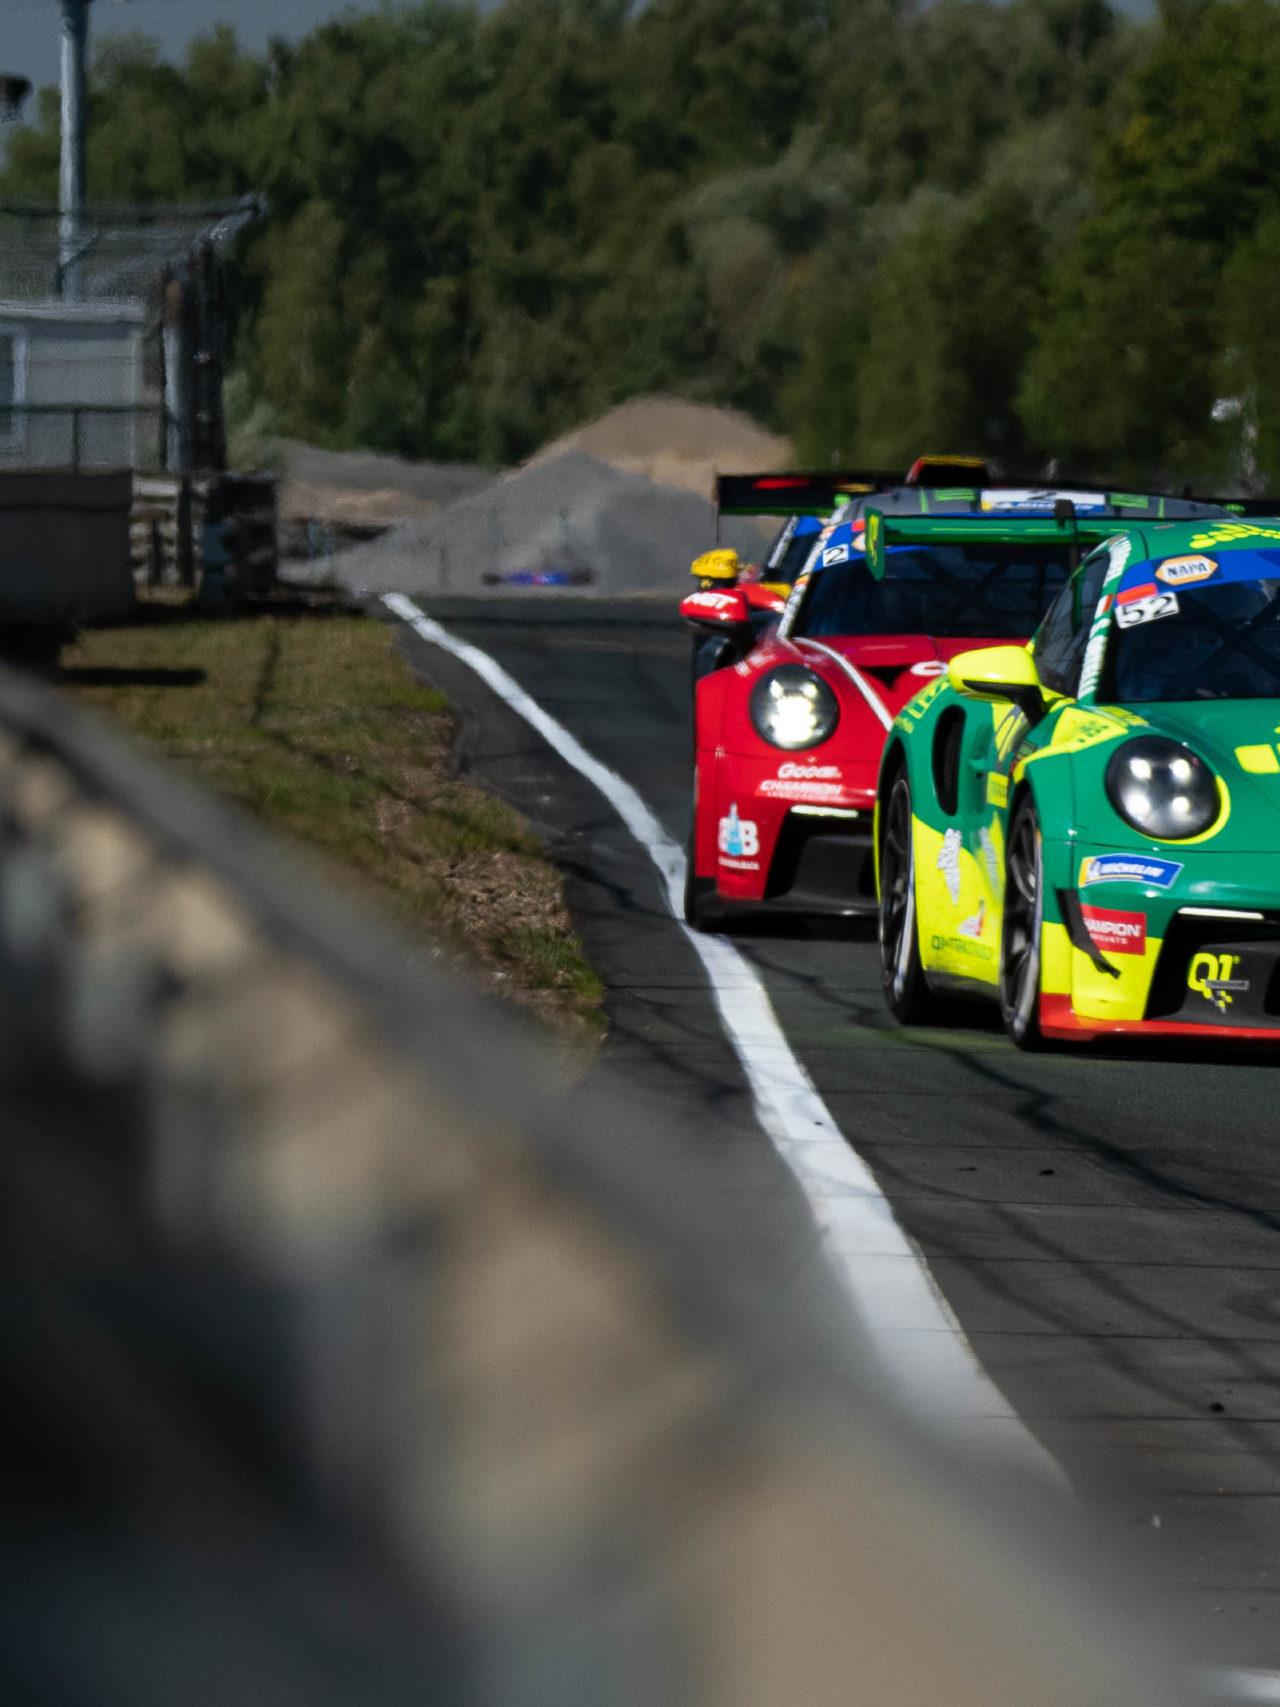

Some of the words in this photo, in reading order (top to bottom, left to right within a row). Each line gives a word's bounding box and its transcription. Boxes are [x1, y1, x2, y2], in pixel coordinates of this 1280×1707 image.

[826, 547, 845, 564] 2
[1167, 562, 1208, 577] NAPA
[1121, 595, 1174, 625] 52
